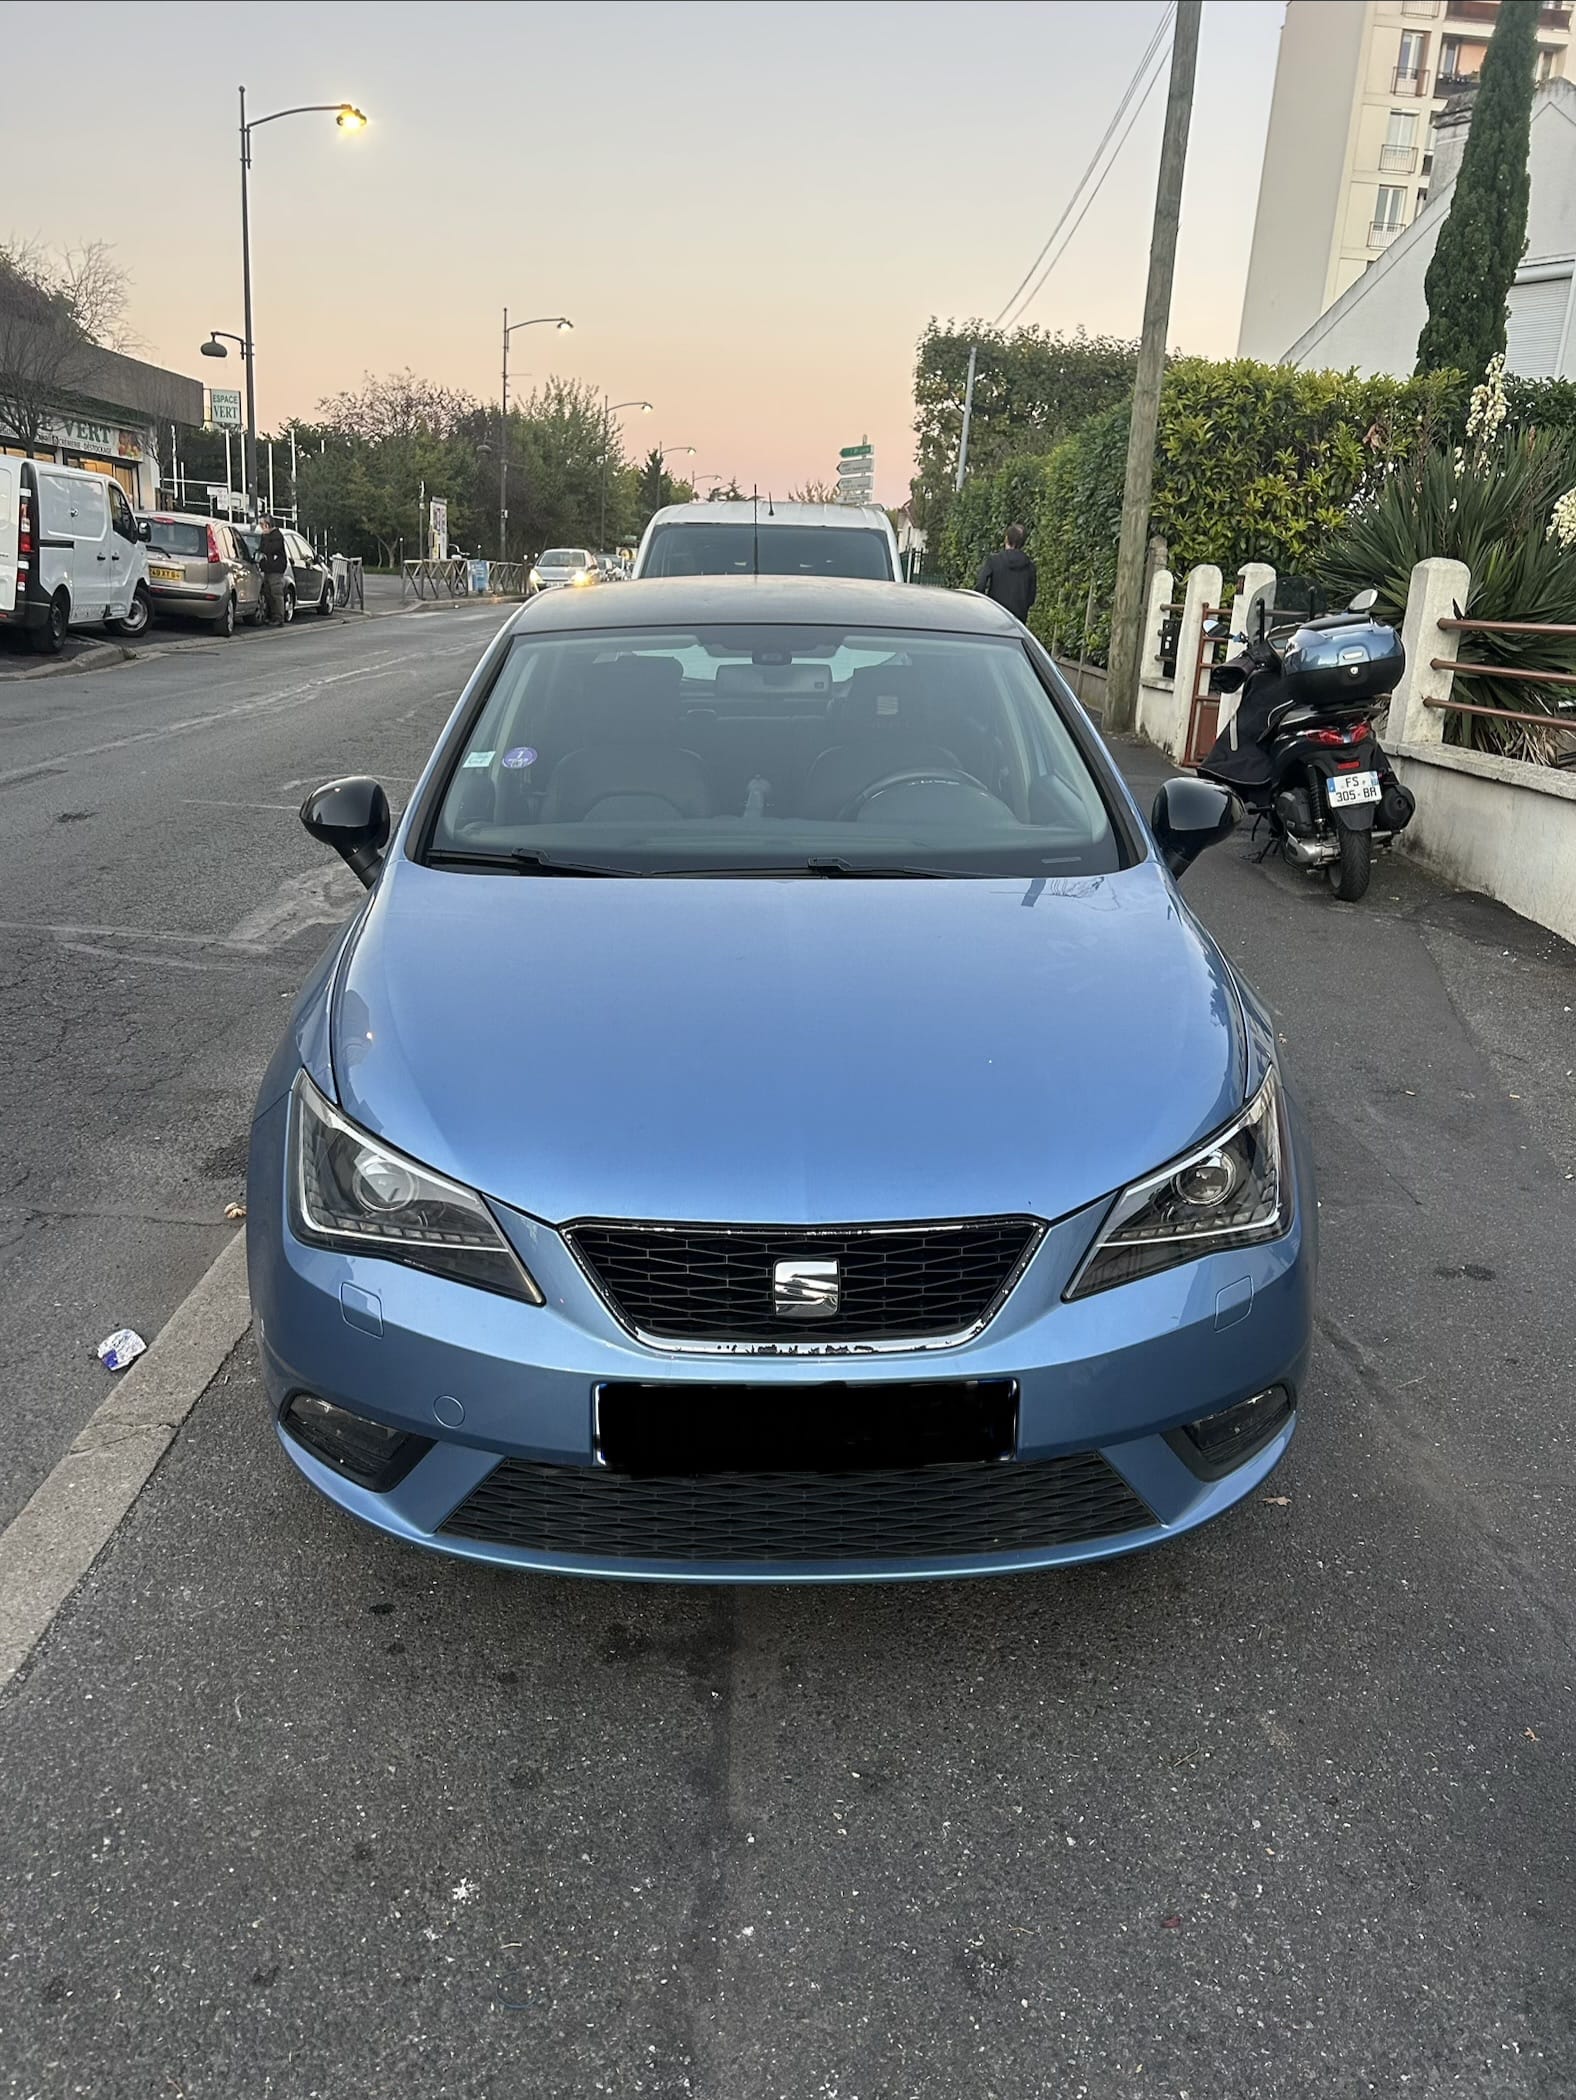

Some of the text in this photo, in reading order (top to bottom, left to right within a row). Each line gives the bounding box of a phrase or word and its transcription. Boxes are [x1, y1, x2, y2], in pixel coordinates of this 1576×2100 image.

[213, 394, 238, 404] ESPACE
[213, 405, 239, 418] VERT
[64, 420, 111, 444] VERT
[1345, 776, 1360, 788] FS
